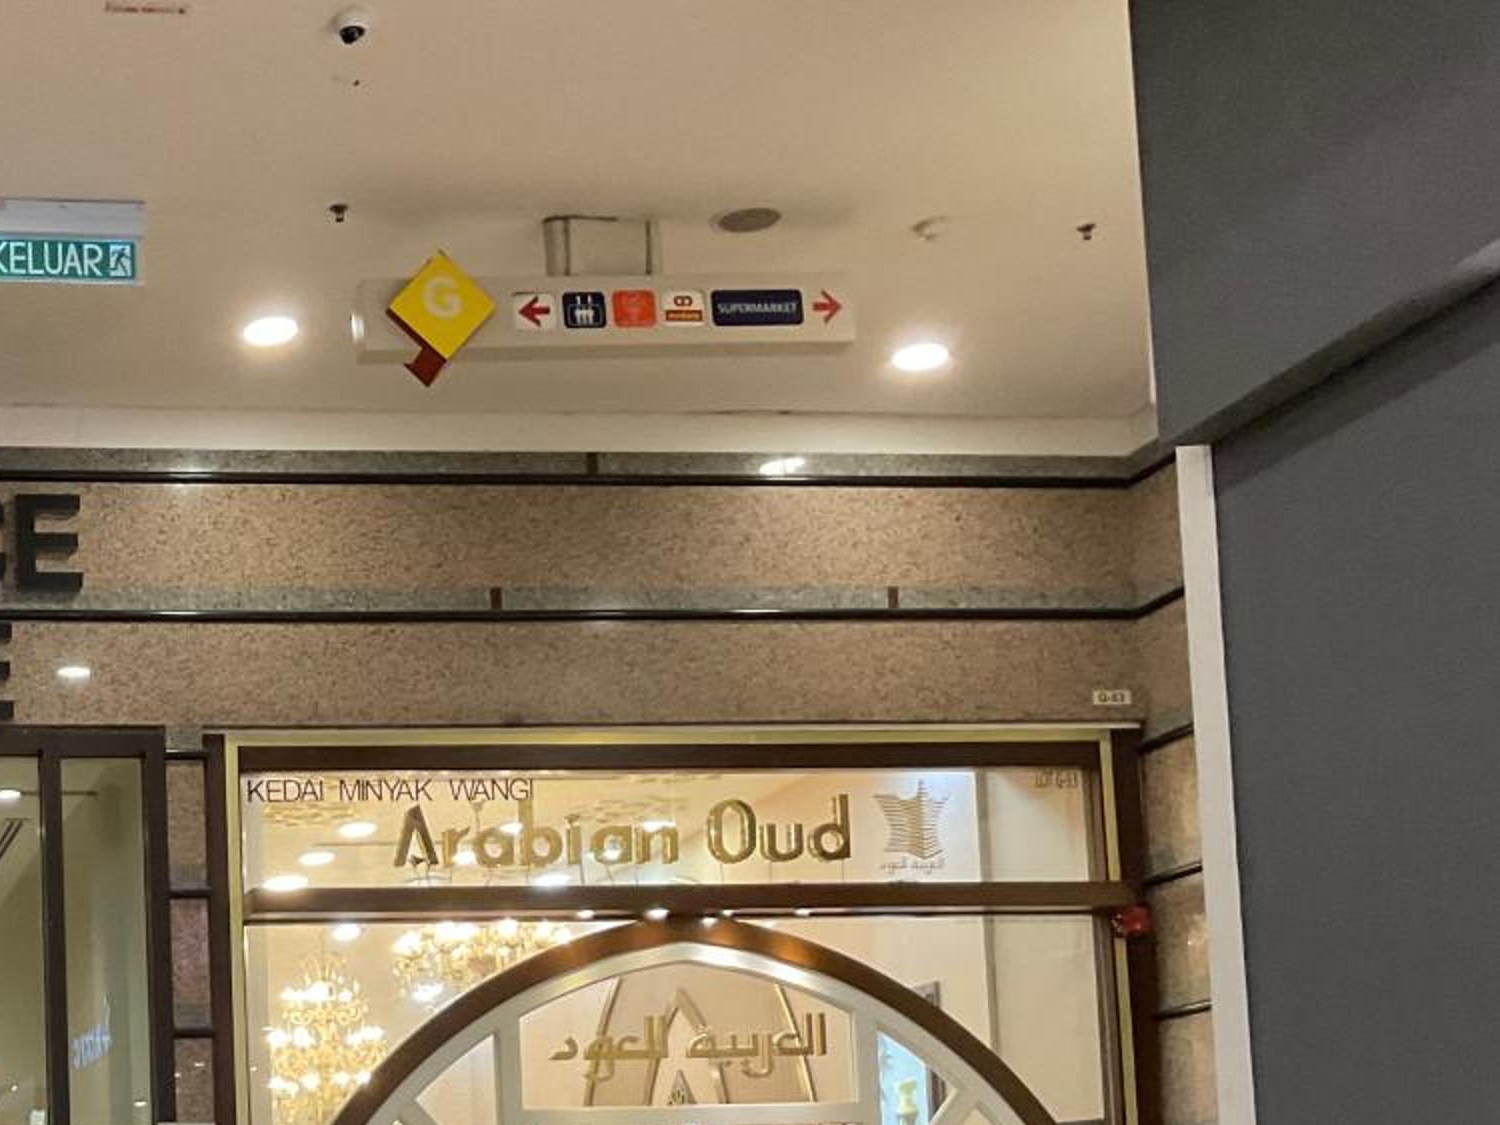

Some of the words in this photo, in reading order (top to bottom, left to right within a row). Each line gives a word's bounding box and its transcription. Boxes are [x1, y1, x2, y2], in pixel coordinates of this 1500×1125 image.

[421, 274, 462, 319] G
[716, 301, 797, 315] SUPERMARKET
[247, 779, 323, 801] KEDAI
[339, 778, 432, 801] MINYAK
[449, 777, 534, 801] WANGI
[393, 795, 679, 868] Arabian
[706, 794, 851, 864] Oud
